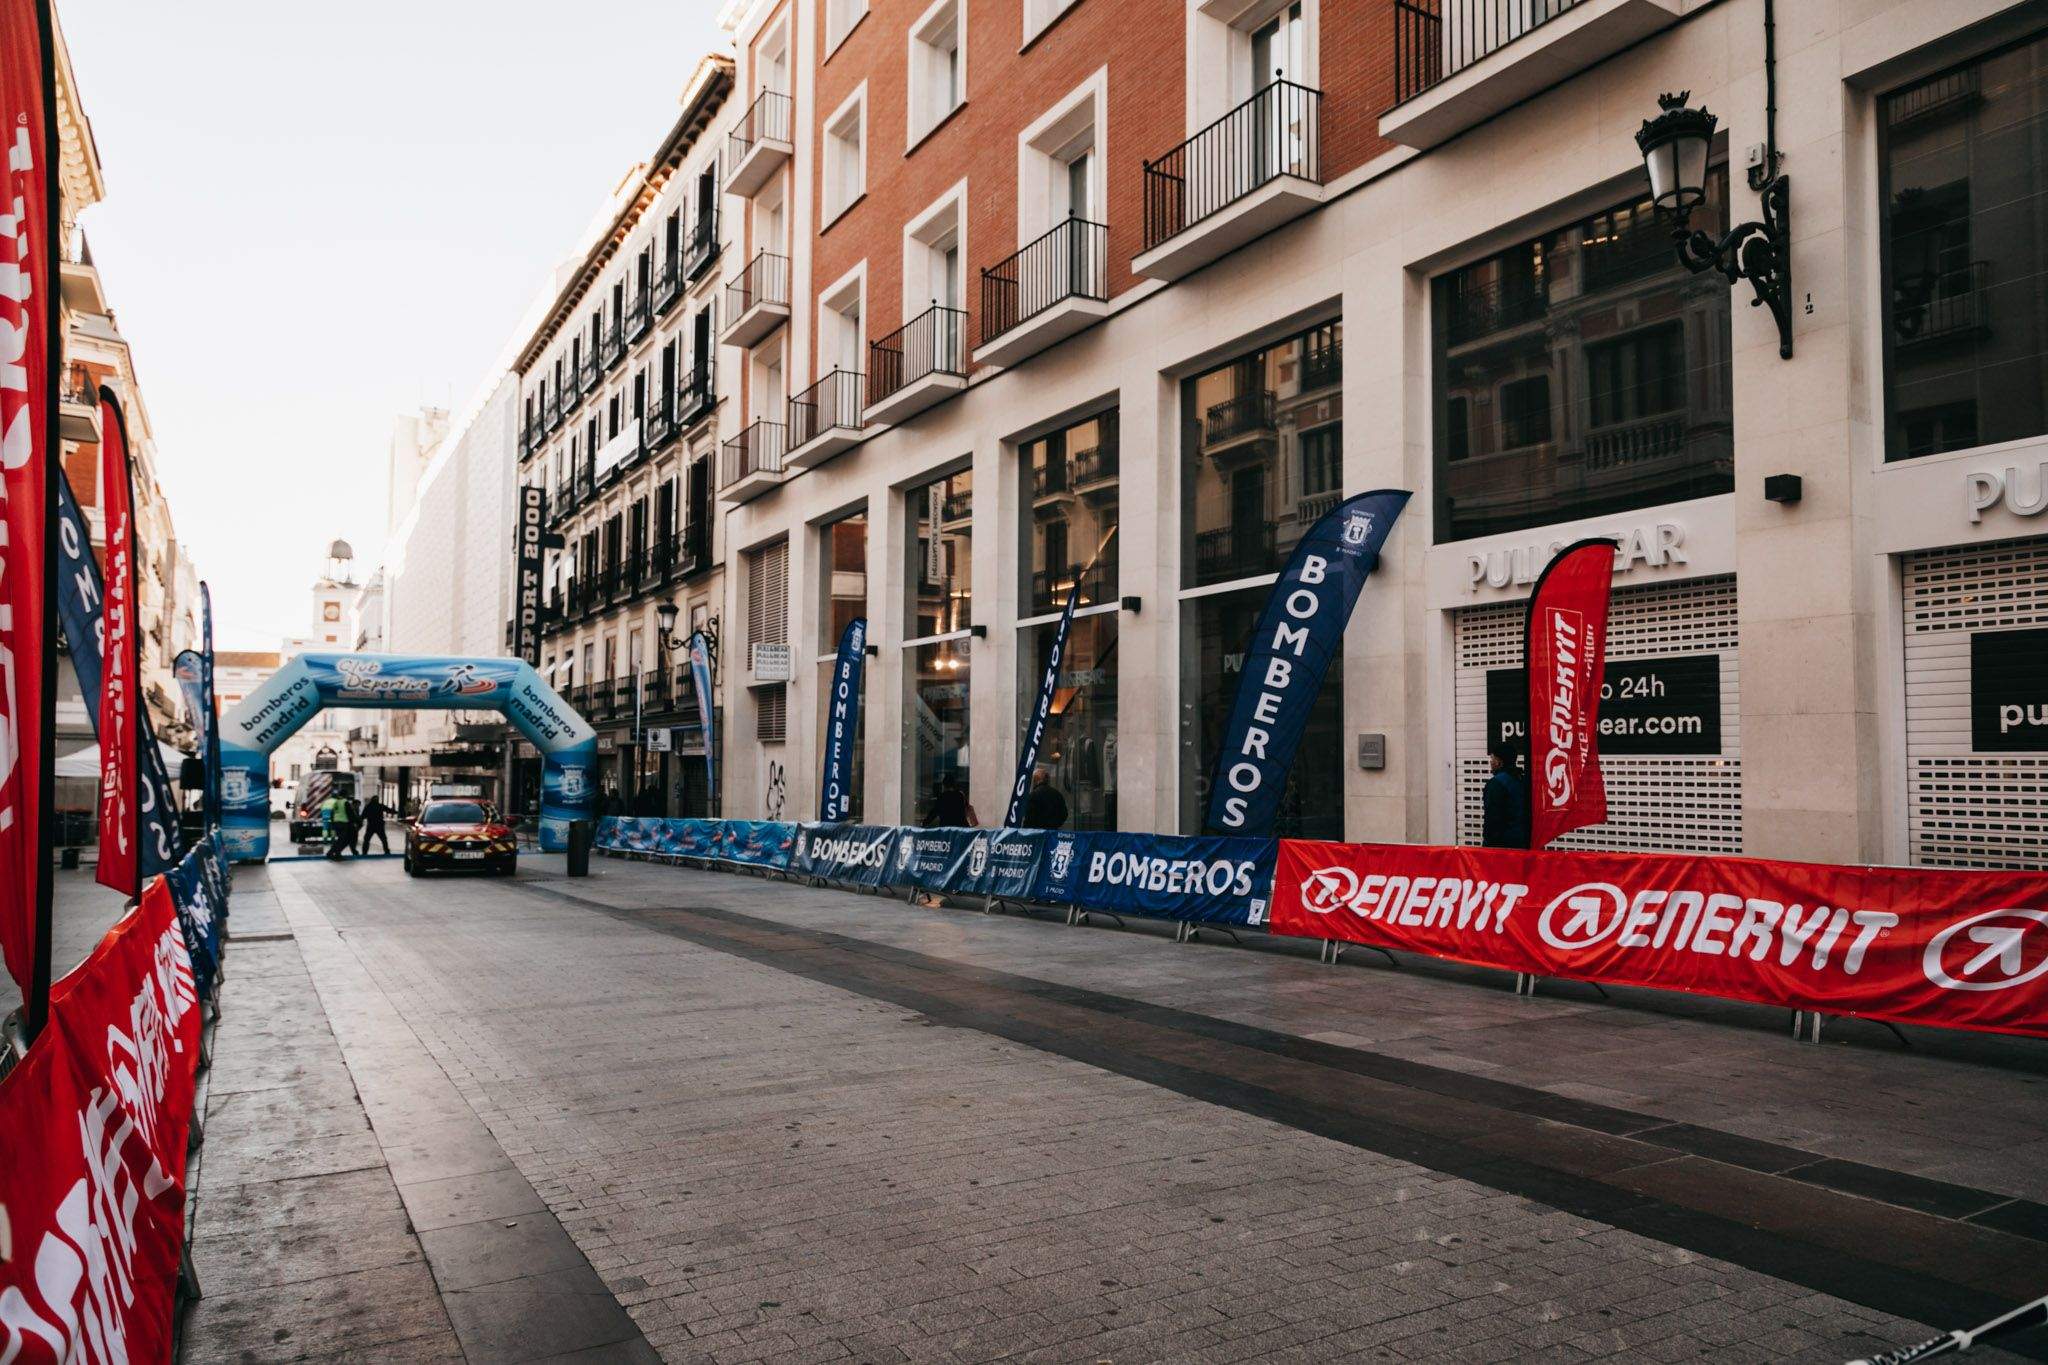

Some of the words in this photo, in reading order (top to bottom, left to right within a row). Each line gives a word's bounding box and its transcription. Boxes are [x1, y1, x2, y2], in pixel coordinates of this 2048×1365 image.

[524, 489, 541, 560] 2000
[520, 569, 539, 663] SPORT
[339, 659, 379, 674] Club
[347, 673, 429, 692] Deportivo
[1551, 612, 1576, 750] ENERVIT
[1620, 674, 1665, 699] 24h
[240, 676, 310, 731] bomberos
[522, 684, 576, 738] bomberos
[1222, 554, 1328, 827] BOMBEROS
[256, 695, 311, 744] madrid
[511, 697, 559, 740] madrid
[827, 662, 851, 819] BOMBEROS
[811, 837, 887, 868] BOMBEROS
[915, 839, 951, 852] BOMBEROS
[919, 861, 944, 873] MADRID
[990, 844, 1033, 857] BOMBEROS
[999, 867, 1026, 879] MADRID
[1088, 852, 1256, 897] BOMBEROS
[1347, 875, 1530, 935] ENERVIT
[1617, 890, 1900, 975] ENERVIT
